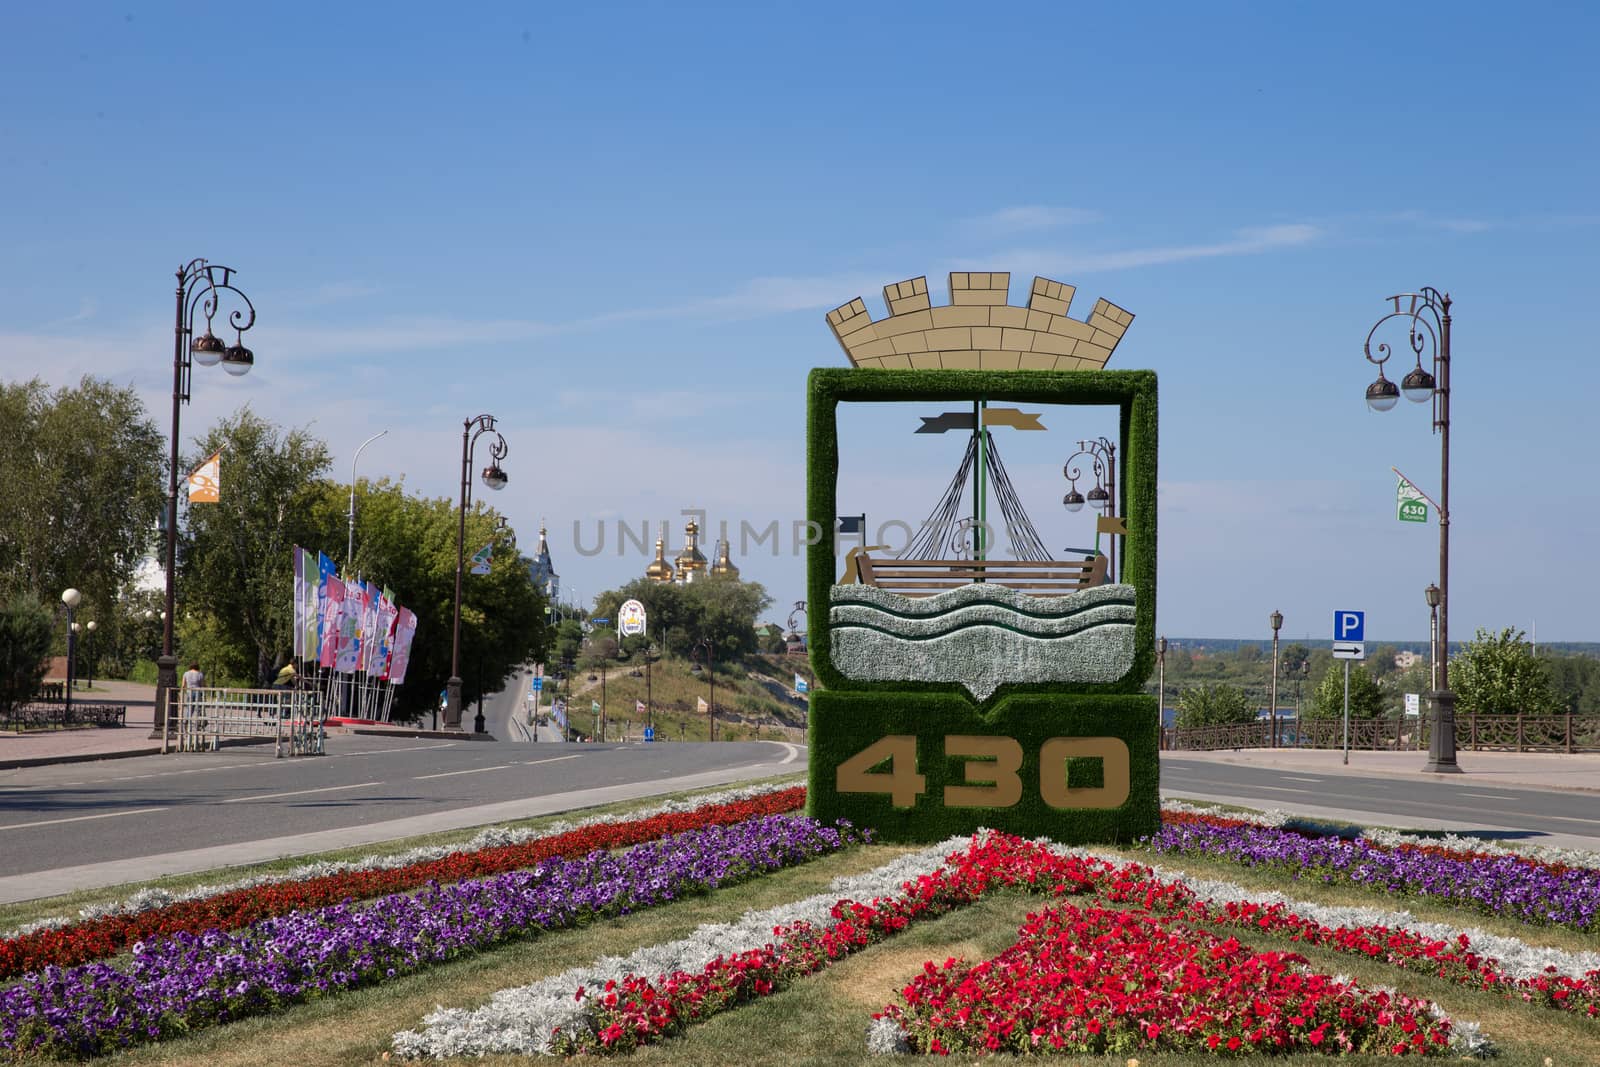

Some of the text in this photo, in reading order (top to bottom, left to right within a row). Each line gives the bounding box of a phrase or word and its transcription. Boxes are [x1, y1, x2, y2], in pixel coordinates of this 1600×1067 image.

[1402, 505, 1425, 515] 430
[1342, 613, 1359, 638] P
[836, 735, 1130, 808] 430
